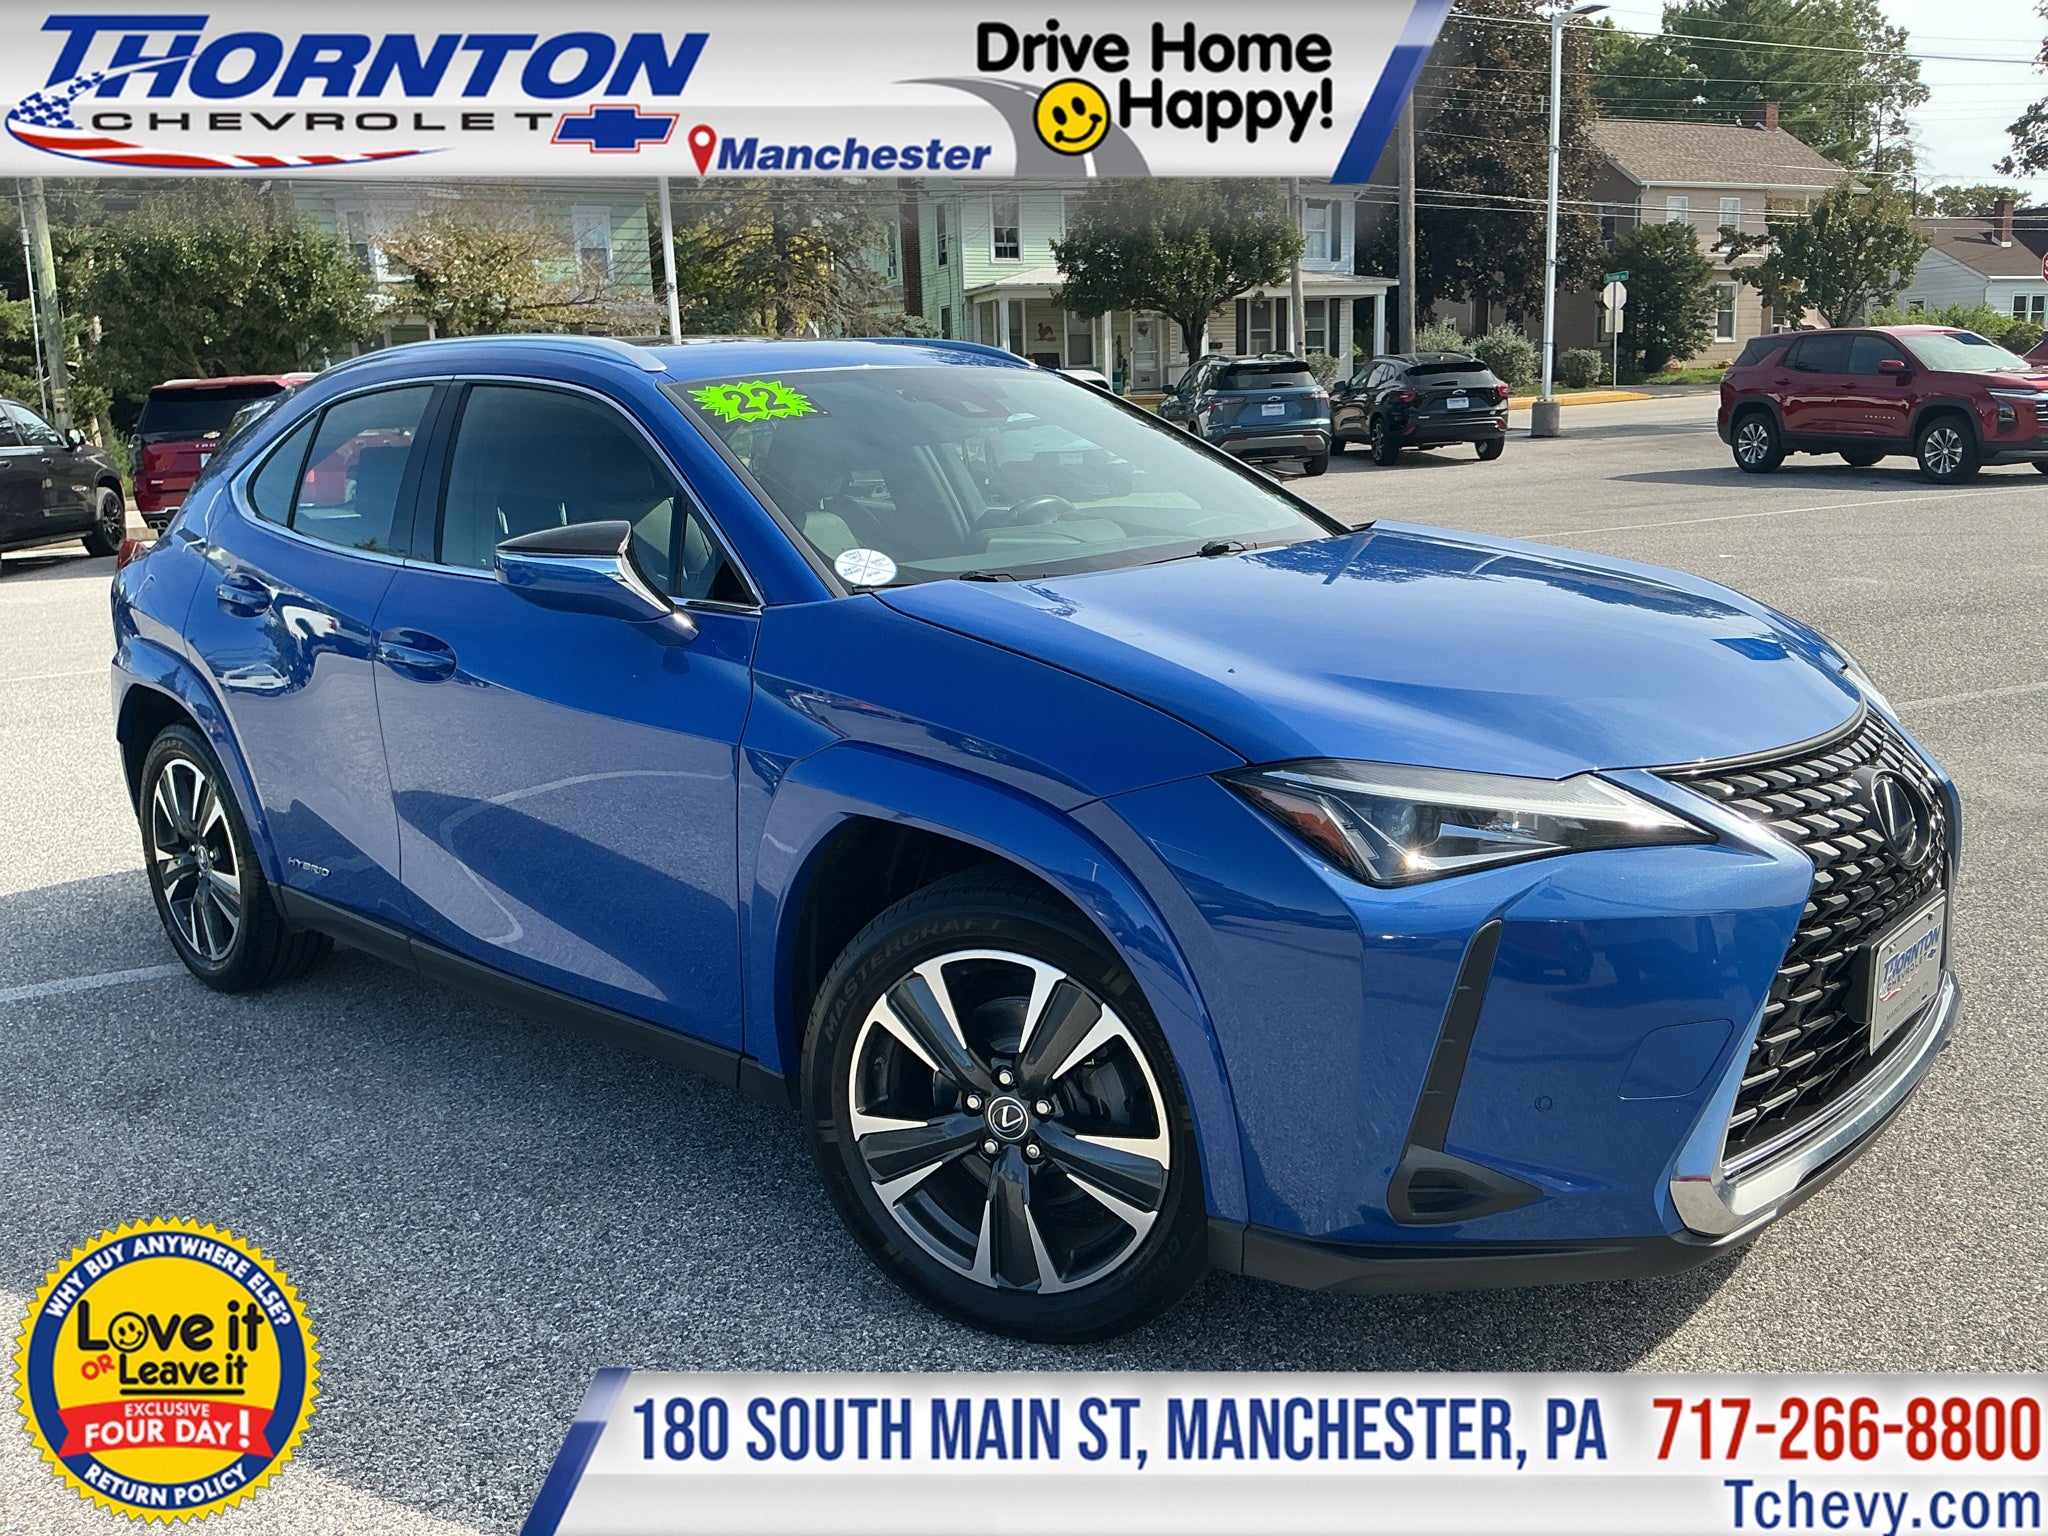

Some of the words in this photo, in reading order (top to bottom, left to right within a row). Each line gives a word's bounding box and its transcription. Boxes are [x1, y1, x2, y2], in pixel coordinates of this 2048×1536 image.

[723, 387, 791, 414] 22
[288, 856, 330, 877] HYBRID
[1883, 923, 1941, 984] THORNTON
[1886, 951, 1927, 991] CHEVROLET
[823, 917, 1009, 1042] MASTERCRAFT
